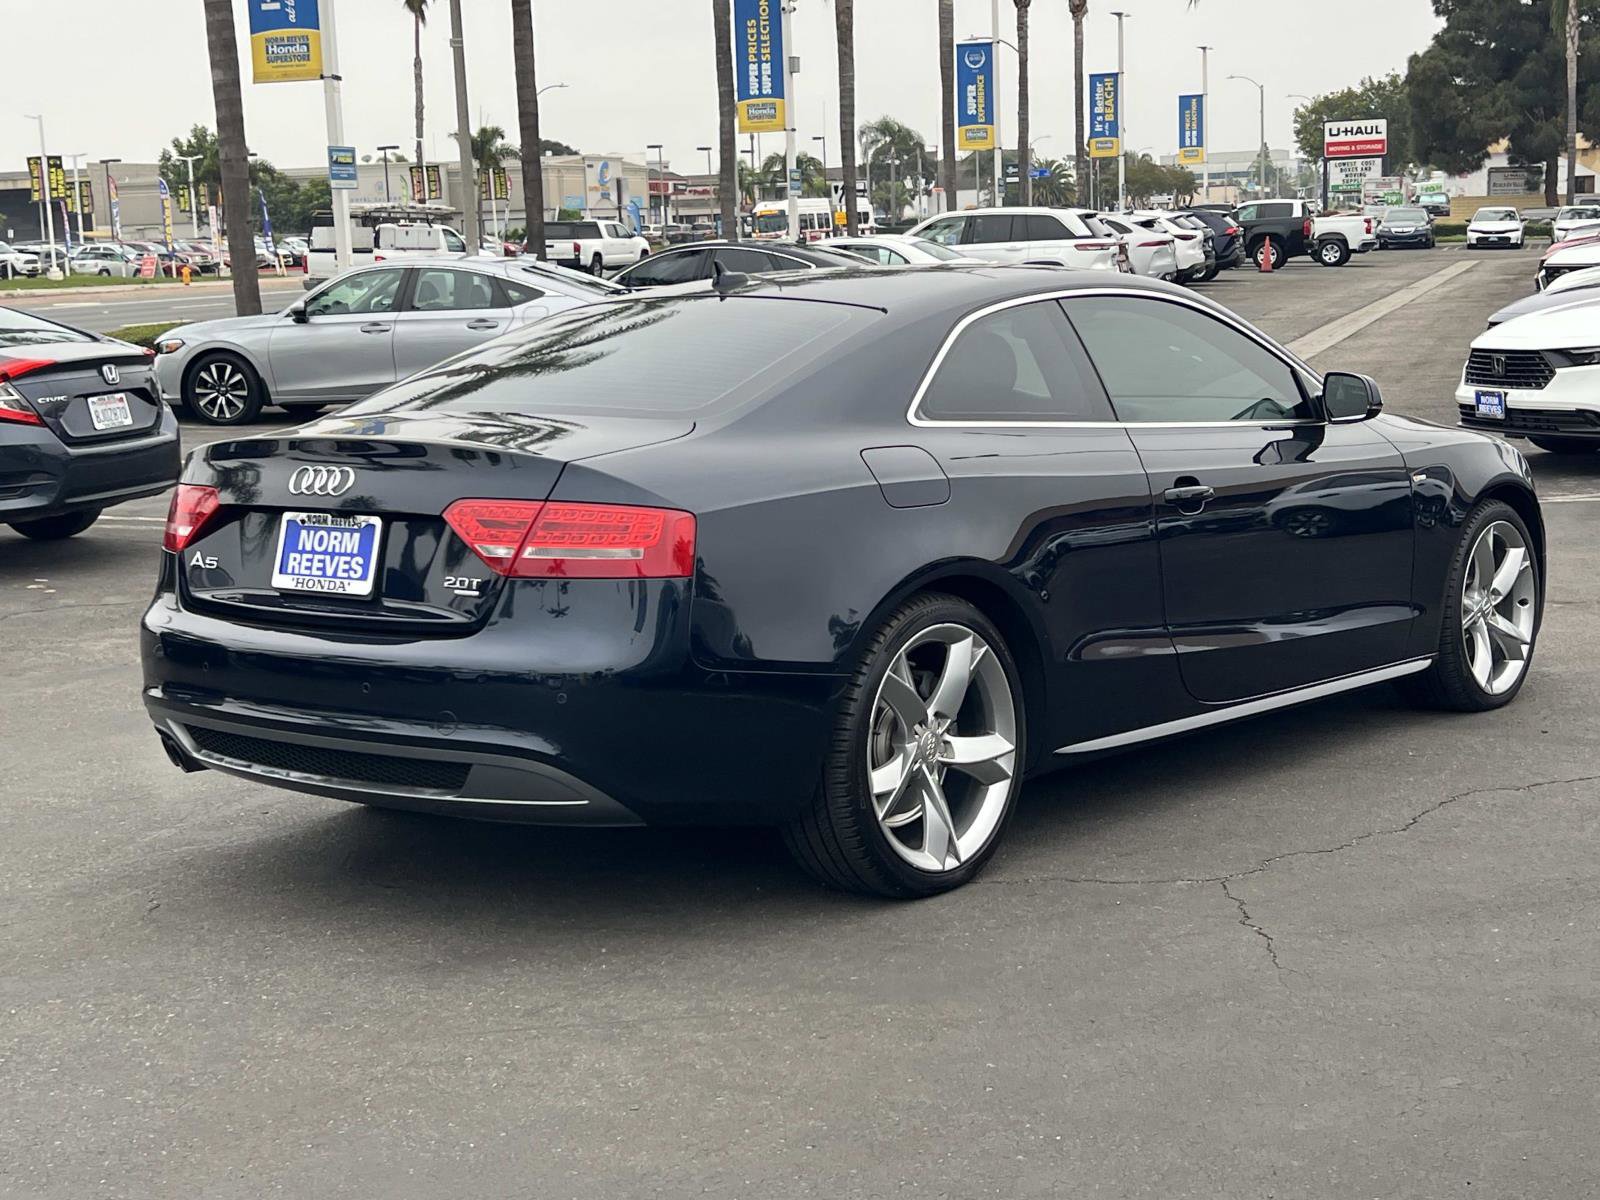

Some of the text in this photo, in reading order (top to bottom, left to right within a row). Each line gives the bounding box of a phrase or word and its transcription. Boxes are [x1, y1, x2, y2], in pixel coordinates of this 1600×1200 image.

[265, 35, 309, 45] NORM REEVES
[268, 44, 308, 54] Honda
[266, 54, 310, 63] SUPERSTORE
[747, 19, 759, 95] SUPER PRICES
[761, 62, 771, 94] SUPER
[967, 84, 977, 115] SUPER
[977, 74, 985, 122] EXPERIENCE
[1094, 81, 1104, 131] It's Better
[1329, 125, 1382, 136] U-HAUL
[37, 395, 68, 403] CIVIC
[1481, 396, 1499, 404] NORM
[1479, 404, 1502, 414] REEVES
[306, 514, 328, 525] NORM
[297, 529, 361, 554] NORM
[190, 550, 218, 569] A5
[287, 552, 364, 578] REEVES
